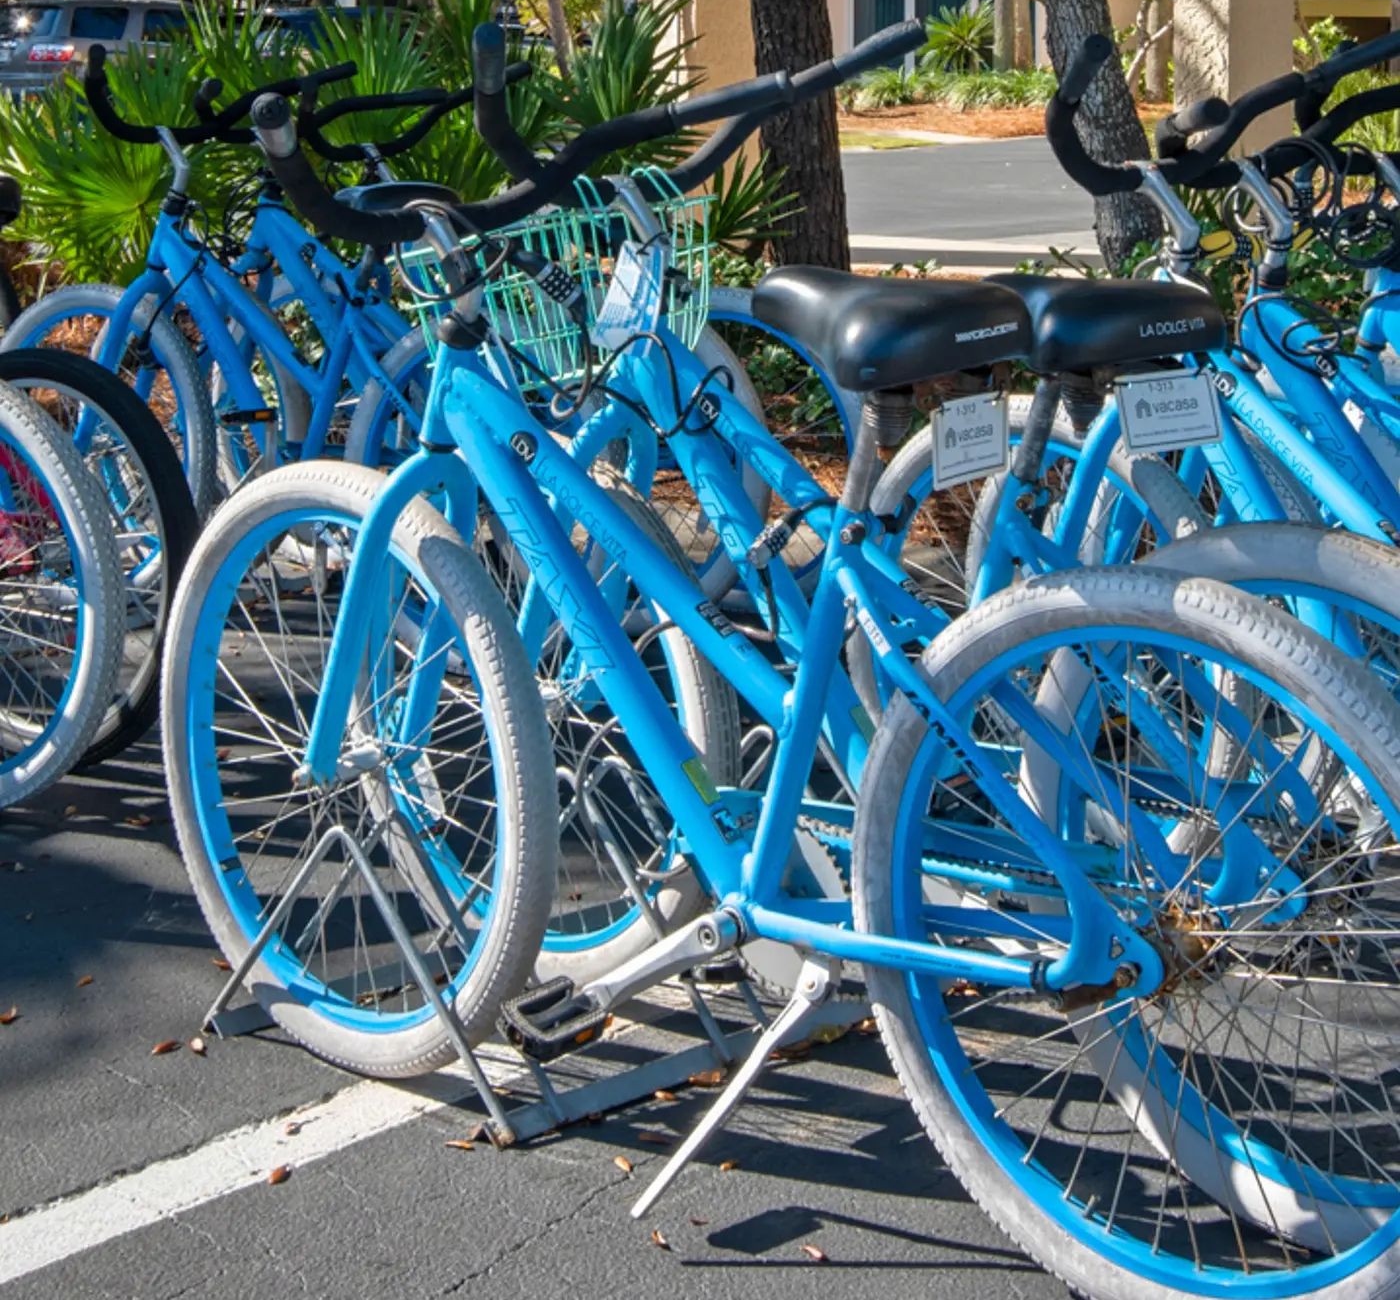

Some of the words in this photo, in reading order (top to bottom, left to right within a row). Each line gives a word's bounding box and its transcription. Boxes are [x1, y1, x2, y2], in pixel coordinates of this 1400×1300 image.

[1140, 323, 1155, 338] LA
[1156, 319, 1188, 336] DOLCE
[1188, 317, 1206, 331] VITA
[1213, 374, 1235, 398] LDV
[1151, 397, 1199, 414] vacasa
[957, 423, 994, 442] vacasa
[1237, 402, 1254, 421] LA
[1253, 418, 1293, 458] DOLCE
[1292, 450, 1314, 486] VITA
[510, 433, 535, 462] LDV
[544, 464, 558, 489] LA
[559, 482, 601, 534] DOLCE
[601, 531, 627, 564] VITA
